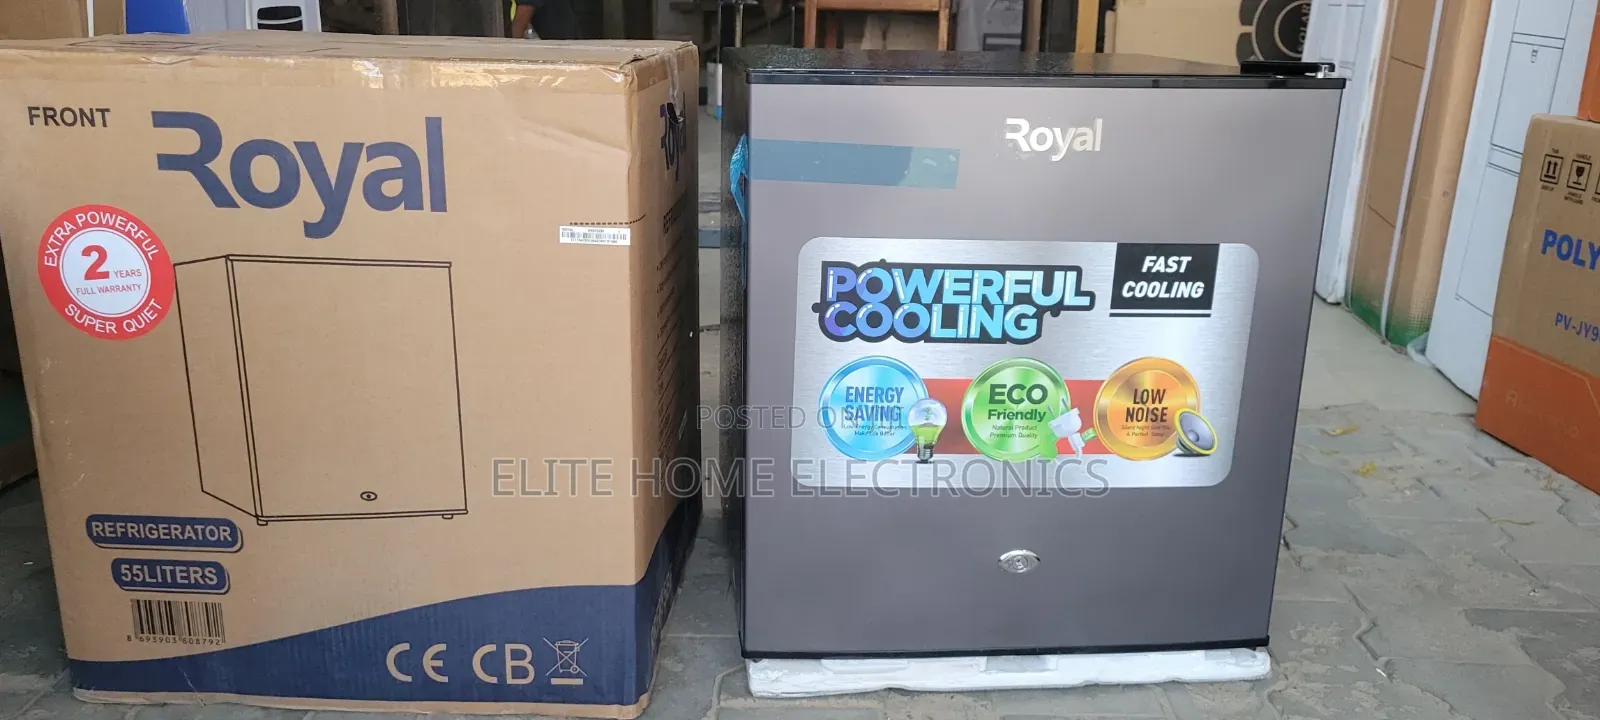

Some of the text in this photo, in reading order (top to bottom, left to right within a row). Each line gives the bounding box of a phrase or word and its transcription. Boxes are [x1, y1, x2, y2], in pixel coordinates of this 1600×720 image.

[28, 106, 111, 128] FRONT
[1005, 117, 1103, 162] Royal
[151, 110, 447, 239] Royal
[44, 211, 159, 267] EXTRA POWERFUL
[1541, 228, 1600, 270] POLY
[81, 244, 142, 281] 2 YEARS
[1142, 255, 1192, 273] FAST
[76, 284, 142, 296] FULL WARRANTY
[826, 265, 1091, 307] POWERFUL
[1122, 281, 1205, 299] COOLING
[65, 298, 162, 334] SUPER QUIET
[825, 301, 1039, 340] COOLING
[1555, 312, 1600, 341] PV-JY9
[846, 386, 904, 403] ENERGY
[989, 384, 1048, 404] ECO
[1133, 389, 1166, 404] LOW
[845, 405, 901, 421] SAVING
[988, 409, 1046, 422] Friendly
[1125, 407, 1168, 422] NOISE
[91, 520, 232, 543] REFRIGERATOR
[120, 564, 218, 586] 55LITERS
[386, 643, 449, 683] CE
[472, 643, 536, 685] CB
